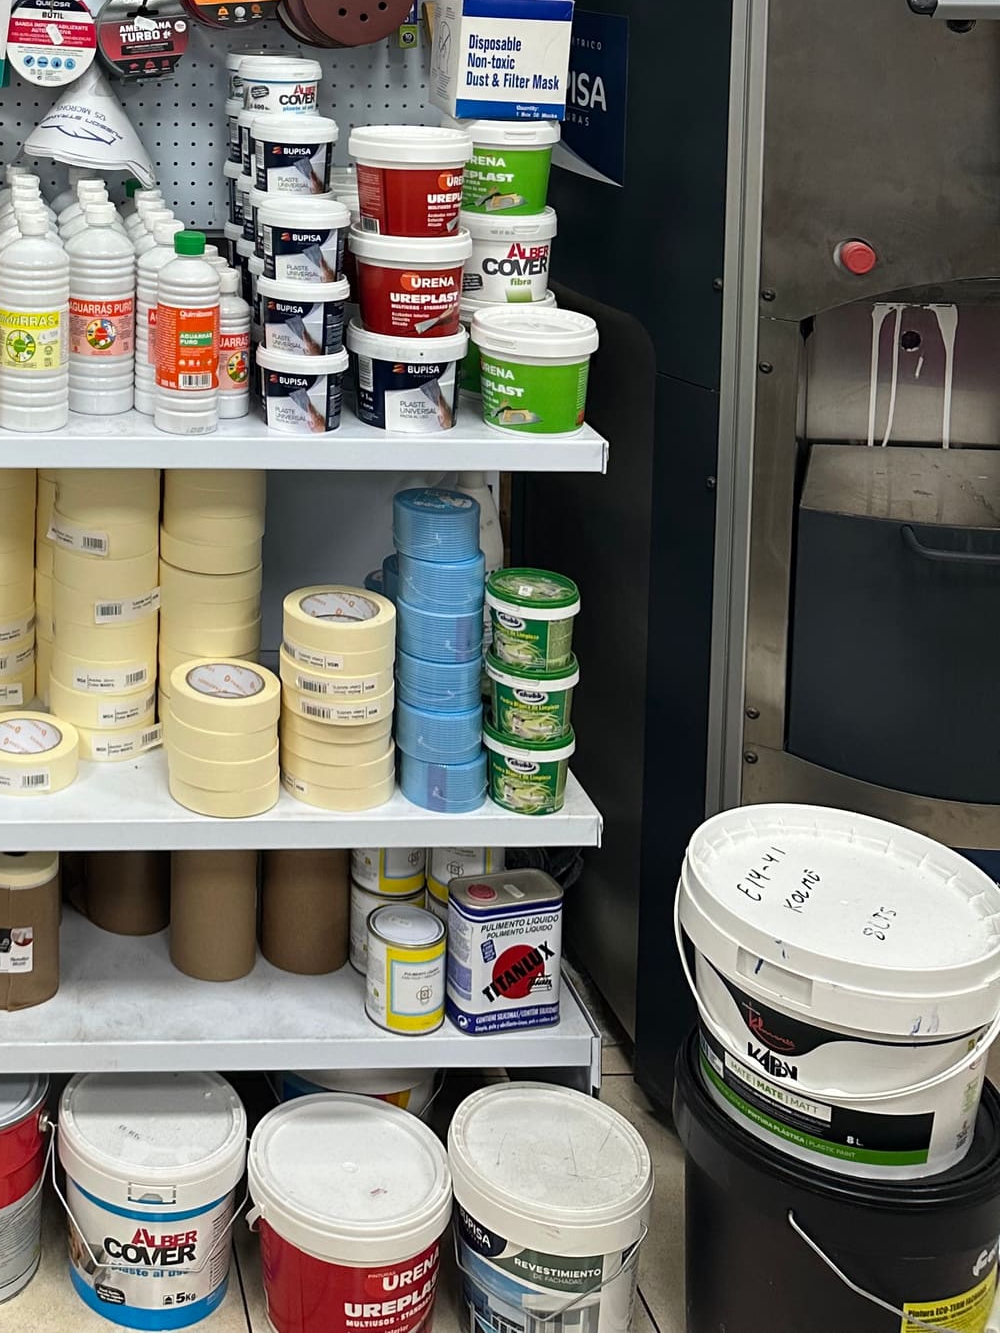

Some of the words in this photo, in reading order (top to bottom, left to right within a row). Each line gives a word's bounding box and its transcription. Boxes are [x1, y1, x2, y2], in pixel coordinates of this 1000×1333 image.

[120, 29, 161, 43] TURBO
[469, 34, 521, 53] Disposable
[467, 53, 515, 69] Non-toxic
[466, 72, 489, 87] Dust
[492, 76, 501, 87] &
[503, 73, 529, 89] Filter
[532, 75, 559, 90] Mask
[279, 92, 315, 106] COVER
[292, 233, 321, 242] BUPISA
[507, 243, 549, 258] ALBER
[482, 258, 547, 275] COVER
[510, 277, 532, 286] fibra
[390, 292, 458, 303] UREPLAST
[276, 303, 303, 314] BUPISA
[408, 365, 440, 374] BUPISA
[279, 376, 308, 386] BUPISA
[481, 920, 525, 933] PULIMENTO
[487, 927, 524, 939] POLIMENTO
[482, 941, 555, 1003] TITANLUX
[756, 1079, 784, 1100] MATE
[790, 1097, 819, 1115] MATT
[846, 1136, 854, 1144] 8
[131, 1228, 198, 1248] ALBER
[104, 1237, 197, 1266] COVER
[514, 1258, 601, 1278] REVESTIMIENTO
[533, 1273, 543, 1281] DE
[544, 1275, 582, 1285] FACHADAS
[346, 1317, 394, 1327] MULTIUSOS
